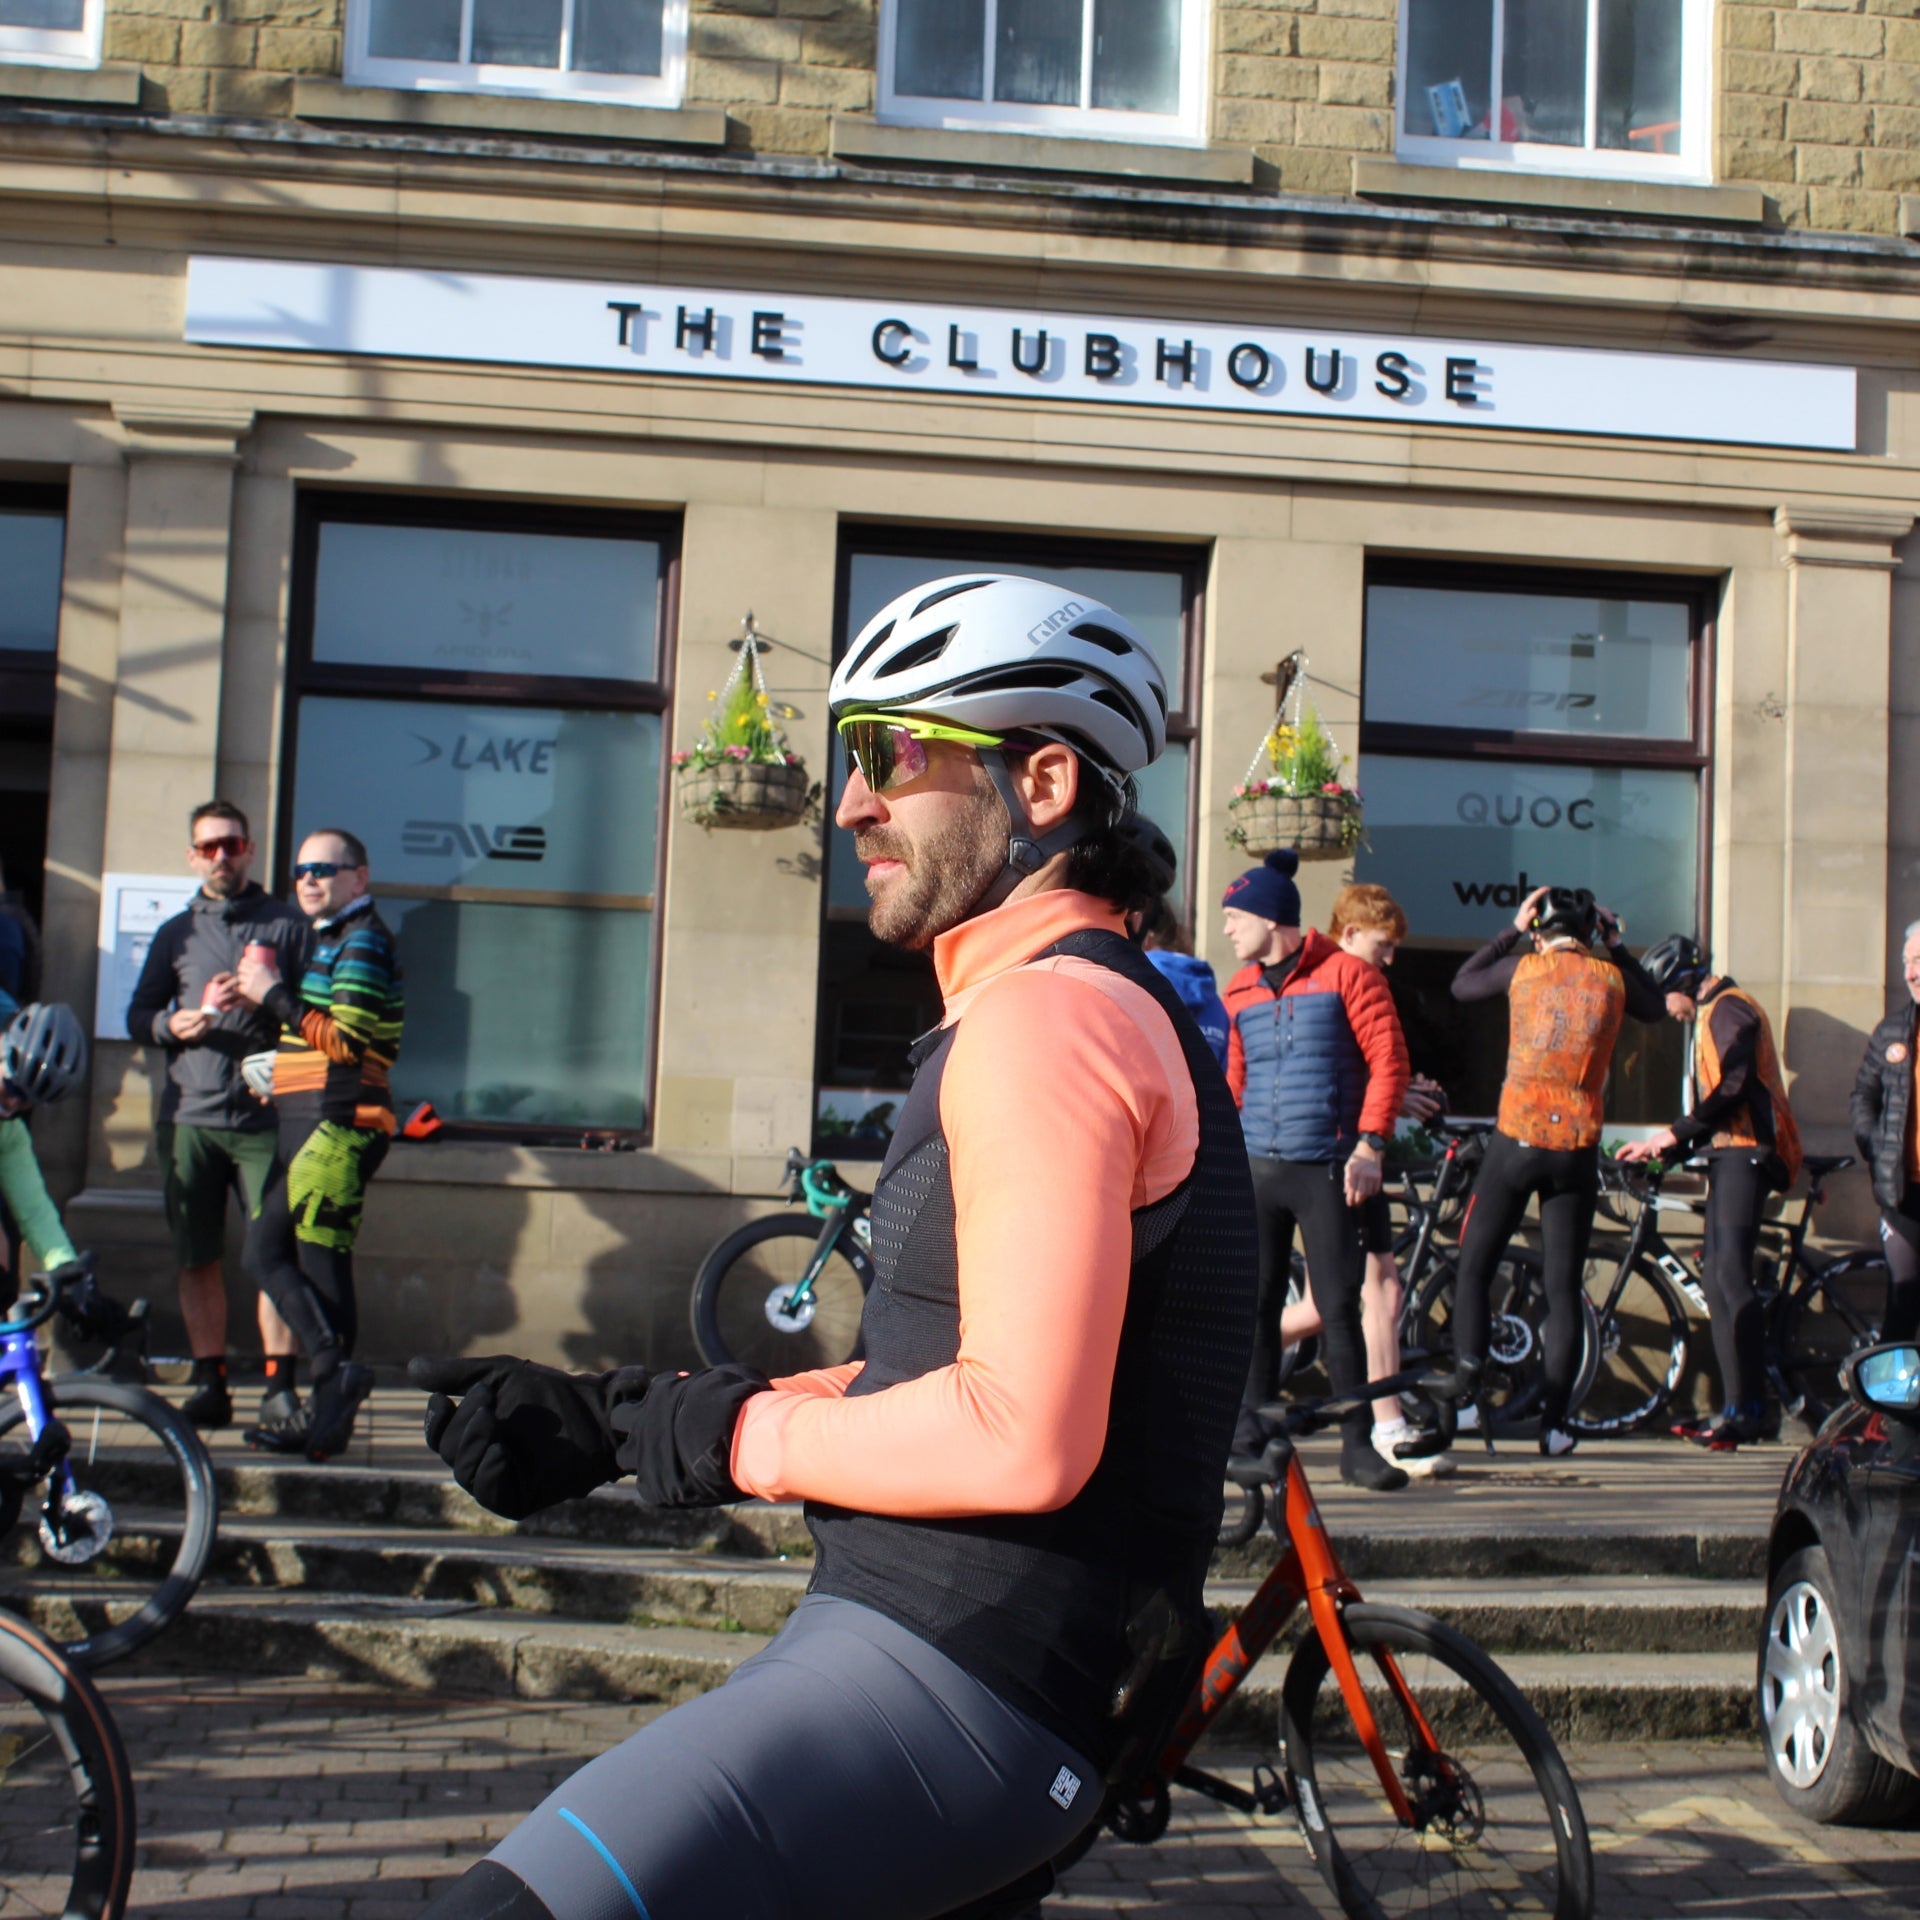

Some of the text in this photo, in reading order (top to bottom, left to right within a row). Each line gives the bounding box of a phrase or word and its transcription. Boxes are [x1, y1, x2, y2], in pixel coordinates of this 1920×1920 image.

[607, 301, 1480, 405] THE CLUBHOUSE
[1027, 601, 1085, 646] GIRO
[451, 735, 557, 774] LAKE
[1456, 792, 1596, 831] QUOC
